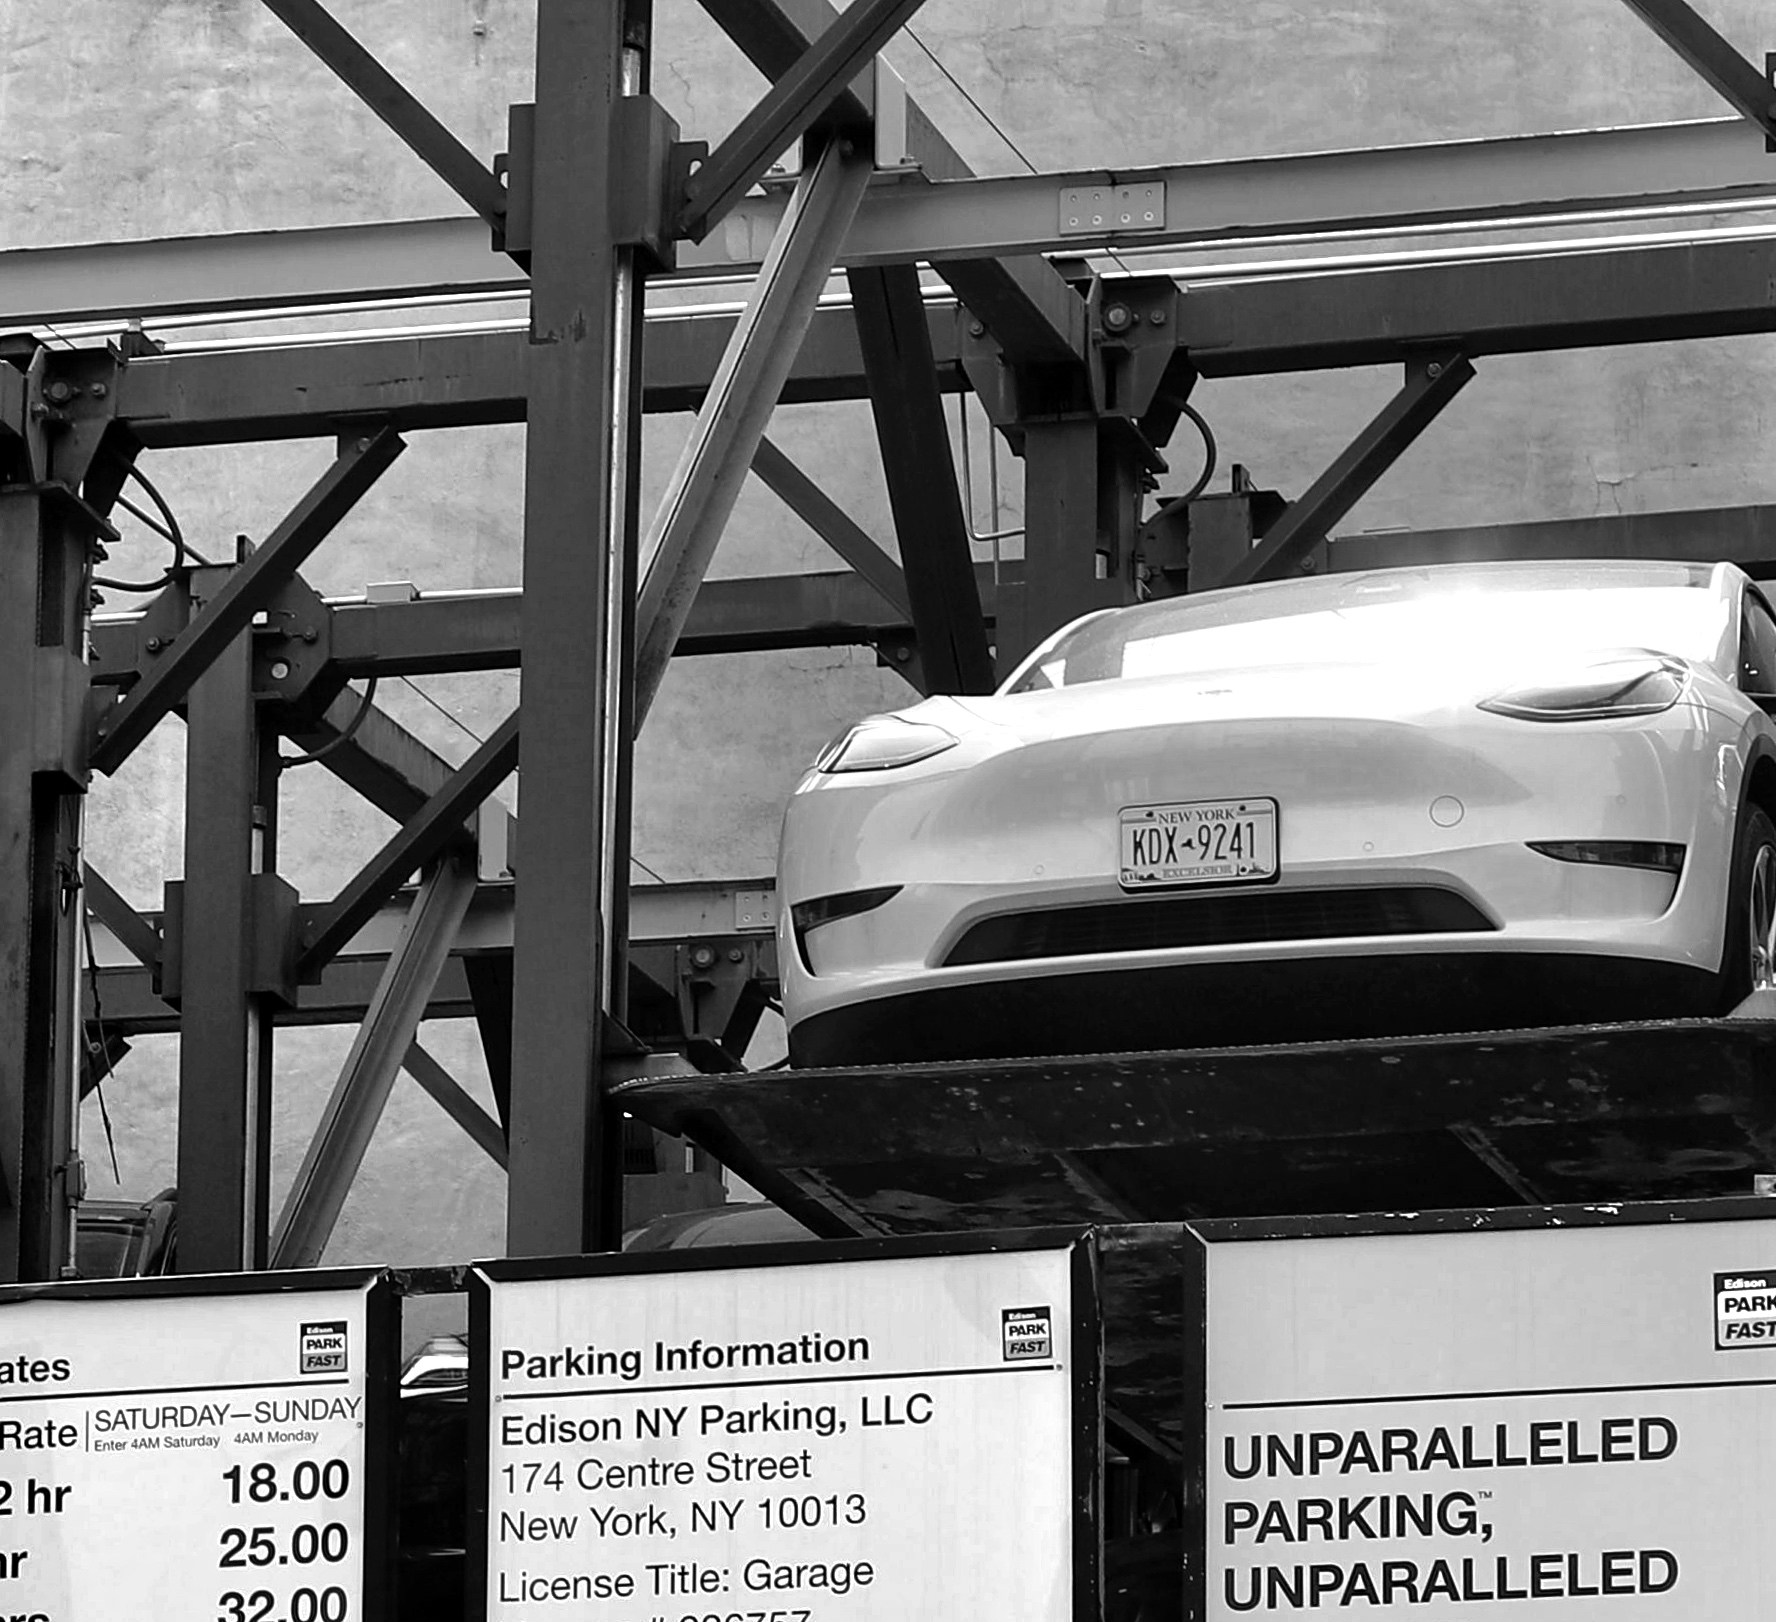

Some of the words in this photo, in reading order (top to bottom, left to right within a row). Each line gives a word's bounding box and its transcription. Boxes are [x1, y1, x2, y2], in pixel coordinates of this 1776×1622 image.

[1159, 811, 1194, 824] NEW
[1196, 808, 1235, 821] YORK
[1723, 1277, 1766, 1290] Edison
[501, 1346, 641, 1381] Parking
[656, 1332, 869, 1371] Information
[501, 1413, 622, 1446] Edison
[636, 1406, 688, 1439] NY
[701, 1401, 846, 1437] Parking,
[862, 1393, 933, 1426] LLC
[502, 1461, 564, 1494] 174
[577, 1457, 694, 1490] Centre
[706, 1449, 812, 1483] Street
[1224, 1417, 1678, 1479] UNPARALLELED
[501, 1511, 578, 1542] New
[590, 1504, 676, 1539] York,
[692, 1499, 744, 1532] NY
[759, 1494, 866, 1528] 10013
[500, 1571, 634, 1602] License
[645, 1563, 729, 1595] Title:
[744, 1559, 874, 1594] Garage
[1224, 1550, 1678, 1611] UNPARALLELED
